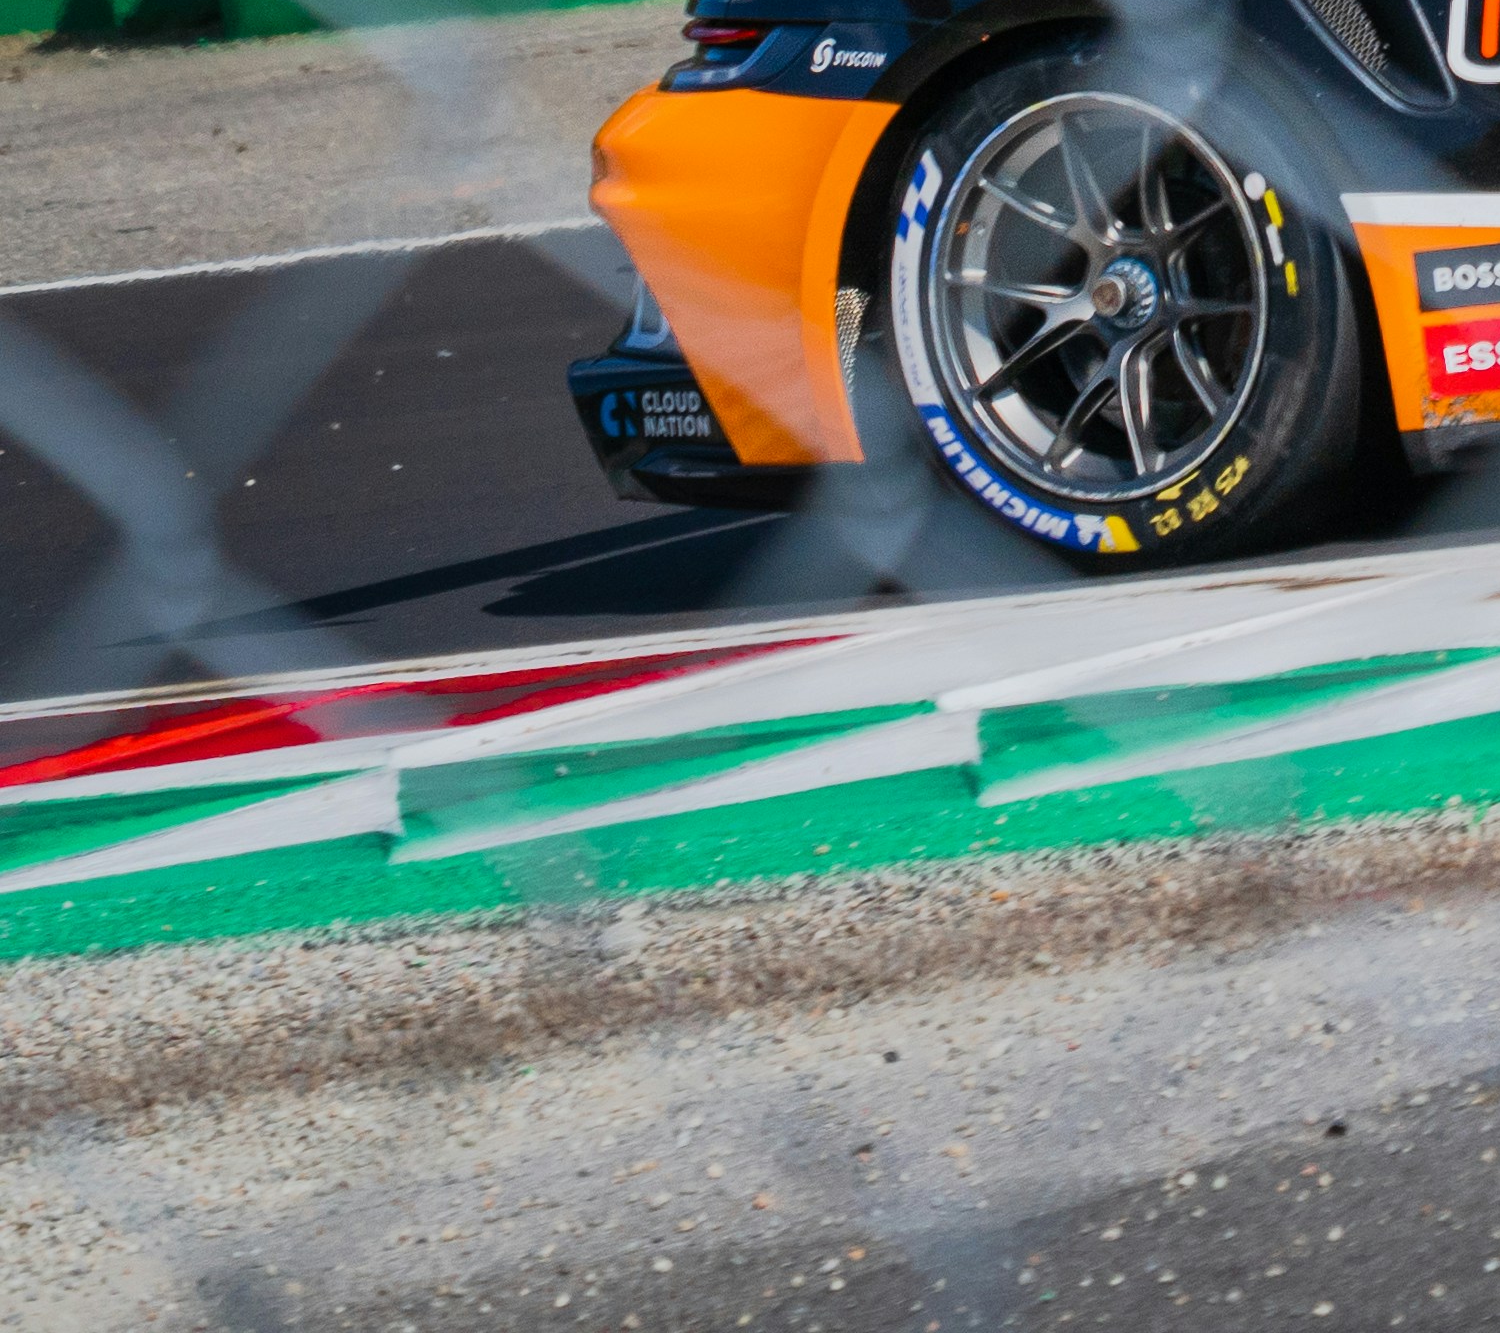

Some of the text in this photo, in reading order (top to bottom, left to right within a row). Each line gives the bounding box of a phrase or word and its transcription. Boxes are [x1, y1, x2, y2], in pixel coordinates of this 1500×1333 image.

[641, 390, 701, 414] CLOUD
[643, 415, 712, 438] NATION
[926, 416, 1072, 541] MICHELIN
